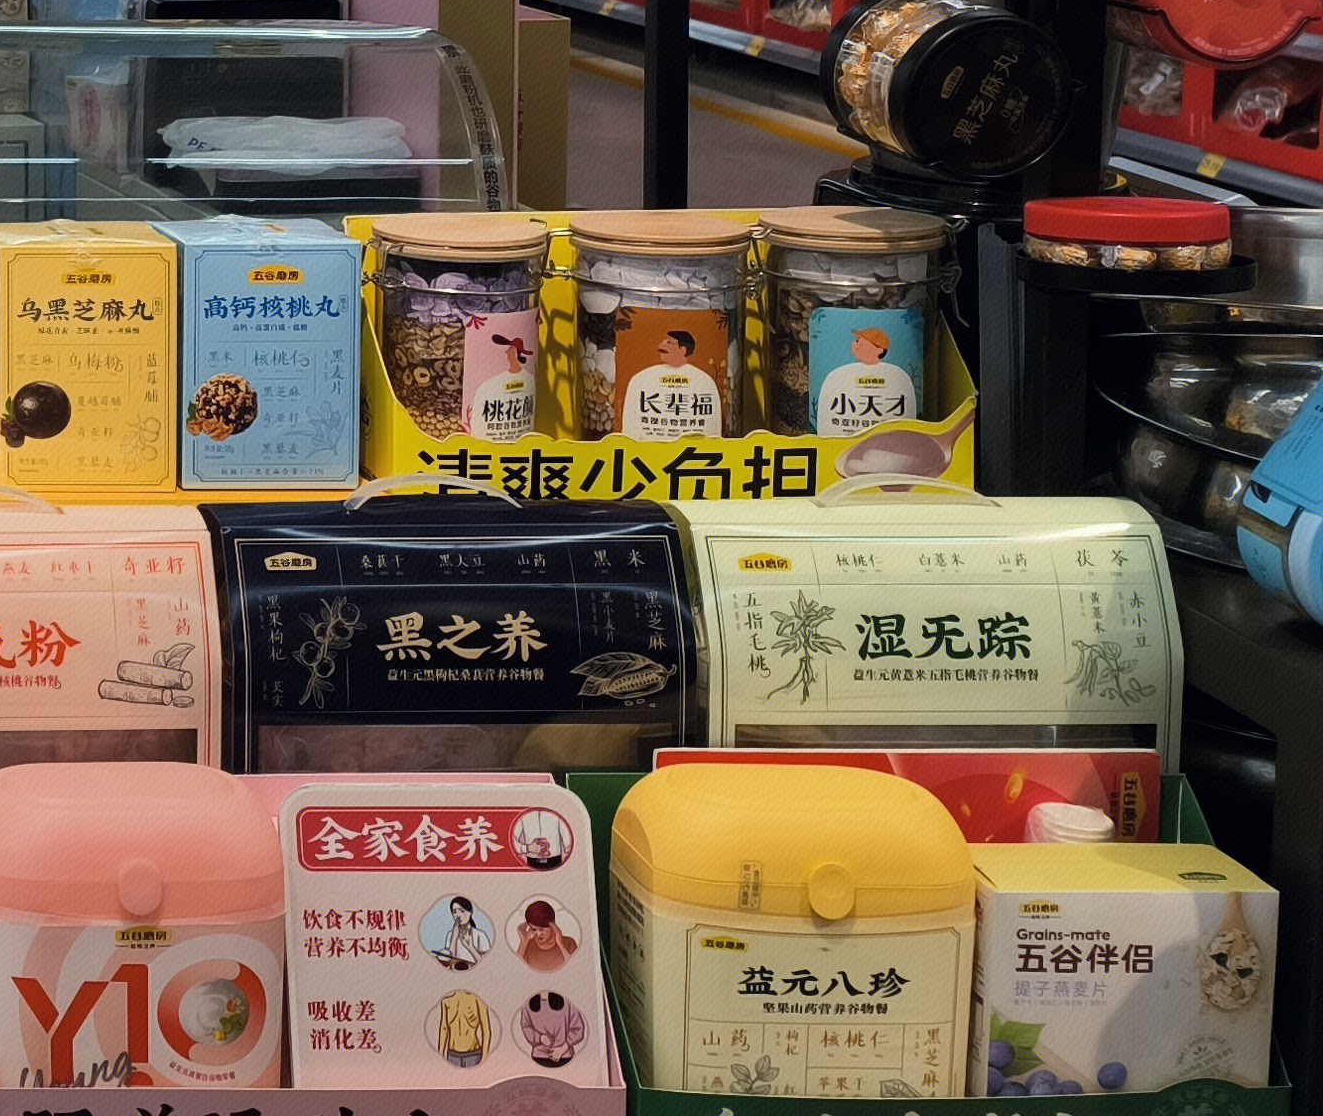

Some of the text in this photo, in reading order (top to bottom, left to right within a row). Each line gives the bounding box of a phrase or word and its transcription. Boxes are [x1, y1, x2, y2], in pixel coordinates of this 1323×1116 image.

[17, 297, 154, 322] 乌黑芝麻丸
[204, 295, 341, 319] 高钙核桃丸
[252, 349, 310, 367] 核桃仁
[639, 391, 713, 417] 长辈福
[830, 394, 907, 416] 小天才
[123, 556, 186, 575] 奇亚籽
[593, 549, 646, 567] 黑米
[1075, 548, 1129, 565] 茯苓
[266, 595, 287, 662] 黑果枸杞
[644, 590, 667, 651] 黑芝麻
[1129, 590, 1151, 649] 赤小豆
[377, 611, 548, 662] 黑之养
[743, 591, 770, 676] 五指毛桃
[308, 815, 505, 863] 全家食养
[303, 909, 405, 930] 饮食不规律
[1017, 928, 1111, 941] Grains-mate
[1015, 944, 1153, 973] 五谷伴侣
[738, 966, 910, 999] 益元八珍
[1014, 980, 1108, 998] 提子燕麦片
[308, 1001, 376, 1022] 吸收差
[703, 1029, 750, 1052] 山药
[820, 1031, 890, 1049] 核桃仁
[921, 1028, 941, 1088] 黑芝麻
